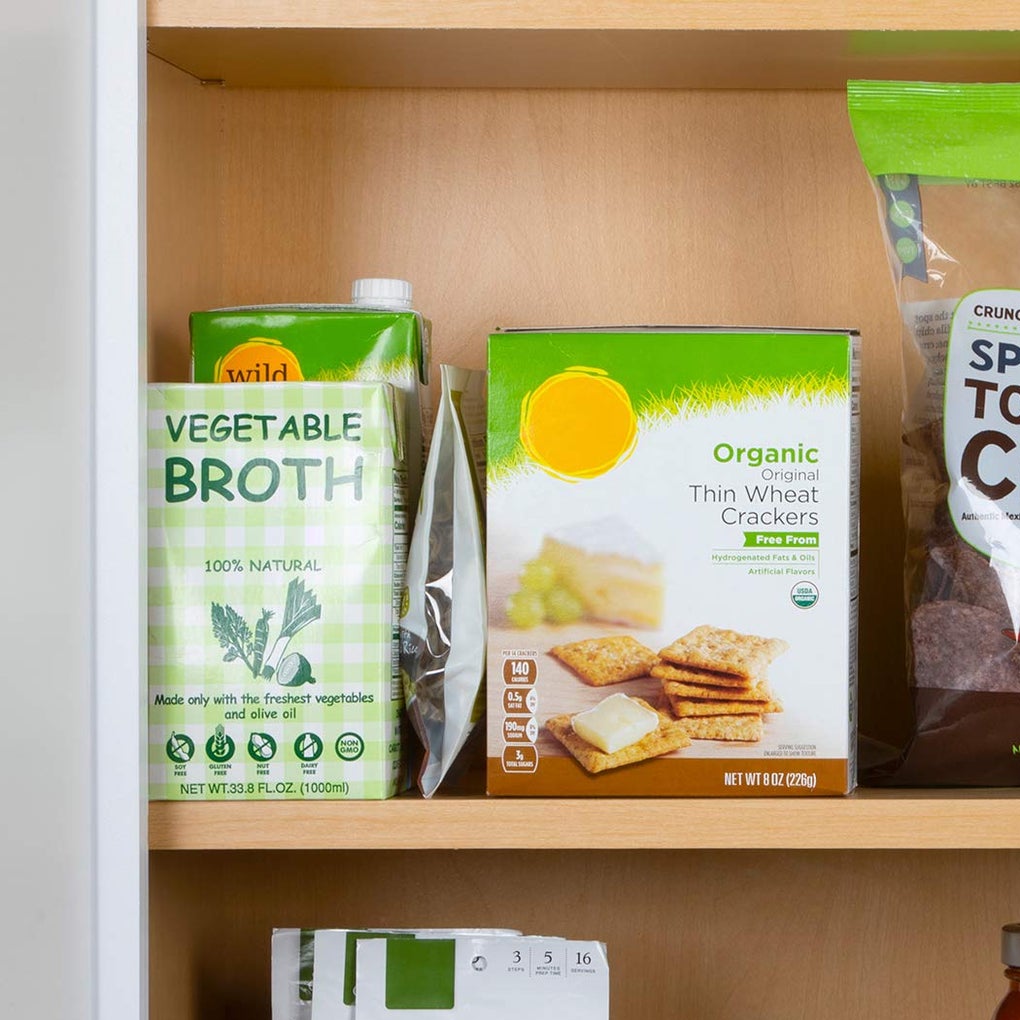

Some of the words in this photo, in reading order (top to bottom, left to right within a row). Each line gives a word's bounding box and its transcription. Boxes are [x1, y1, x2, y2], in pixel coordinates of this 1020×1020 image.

[226, 363, 288, 383] wild
[165, 412, 363, 443] VEGETABLE
[713, 442, 820, 468] Organic
[164, 456, 365, 504] BROTH
[761, 468, 820, 484] Original
[688, 484, 738, 505] Thin
[744, 484, 820, 505] Wheat
[720, 506, 820, 528] Crackers
[755, 534, 783, 546] Free
[785, 534, 817, 546] From
[204, 559, 244, 574] 100%
[249, 558, 322, 574] NATURAL
[711, 553, 770, 564] Hydrogenated
[772, 553, 790, 562] Fats
[791, 553, 798, 562] &
[799, 553, 816, 562] Oils
[748, 567, 784, 576] Artificial
[785, 567, 816, 577] Flavors
[510, 661, 530, 676] 140
[154, 692, 185, 706] Made
[188, 693, 211, 707] only
[213, 692, 238, 706] with
[240, 692, 261, 705] the
[263, 692, 312, 705] freshest
[315, 692, 375, 707] vegetables
[224, 707, 246, 720] and
[250, 707, 278, 719] olive
[282, 707, 297, 719] oil
[339, 739, 360, 747] NON
[339, 746, 360, 754] GMO
[724, 772, 742, 787] NET
[745, 772, 761, 787] WT
[763, 773, 770, 787] 8
[771, 773, 784, 787] OZ
[785, 772, 817, 789] (226g)
[180, 784, 206, 795] NET
[207, 784, 255, 795] WT.33.8
[257, 783, 298, 794] FL.OZ.
[299, 782, 350, 796] (1000ml)
[513, 950, 522, 964] 3
[544, 951, 553, 965] 5
[576, 951, 592, 966] 16
